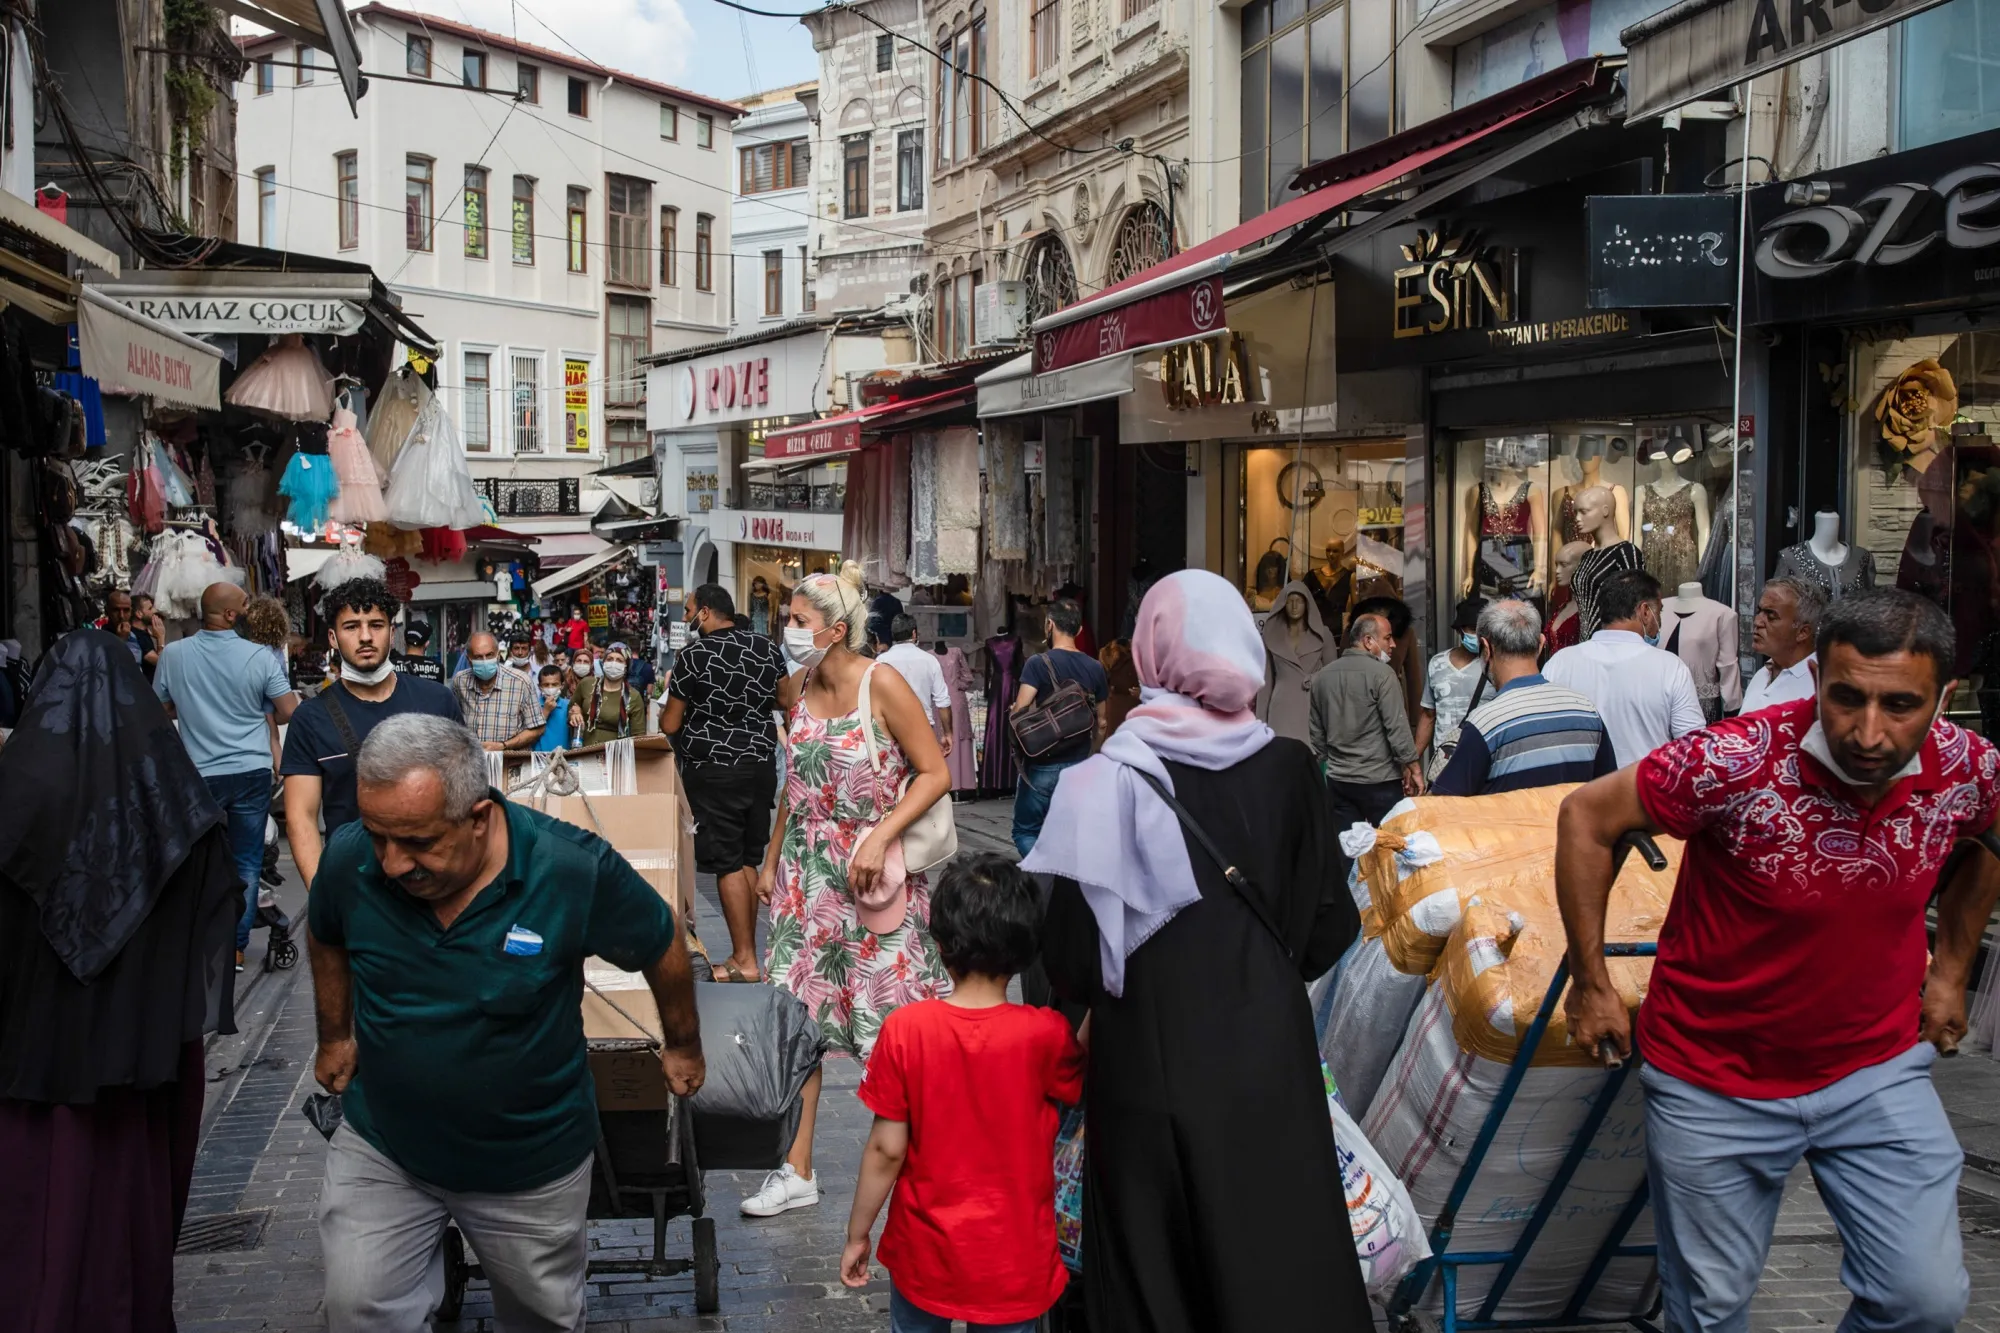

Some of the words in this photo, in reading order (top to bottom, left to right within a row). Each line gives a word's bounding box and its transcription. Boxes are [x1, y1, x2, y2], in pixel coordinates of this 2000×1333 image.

[1744, 0, 1889, 66] AR-
[249, 302, 346, 325] ÇOCUK
[1196, 288, 1212, 322] 52
[1487, 325, 1532, 349] TOPTAN
[1535, 322, 1550, 343] VE
[1552, 313, 1630, 341] PERAKENDE
[127, 342, 161, 382] ALHAS
[164, 356, 192, 391] BUTİK
[704, 357, 769, 411] ROZE
[1740, 420, 1750, 432] 52
[752, 518, 783, 542] ROZE
[413, 663, 440, 674] Angels
